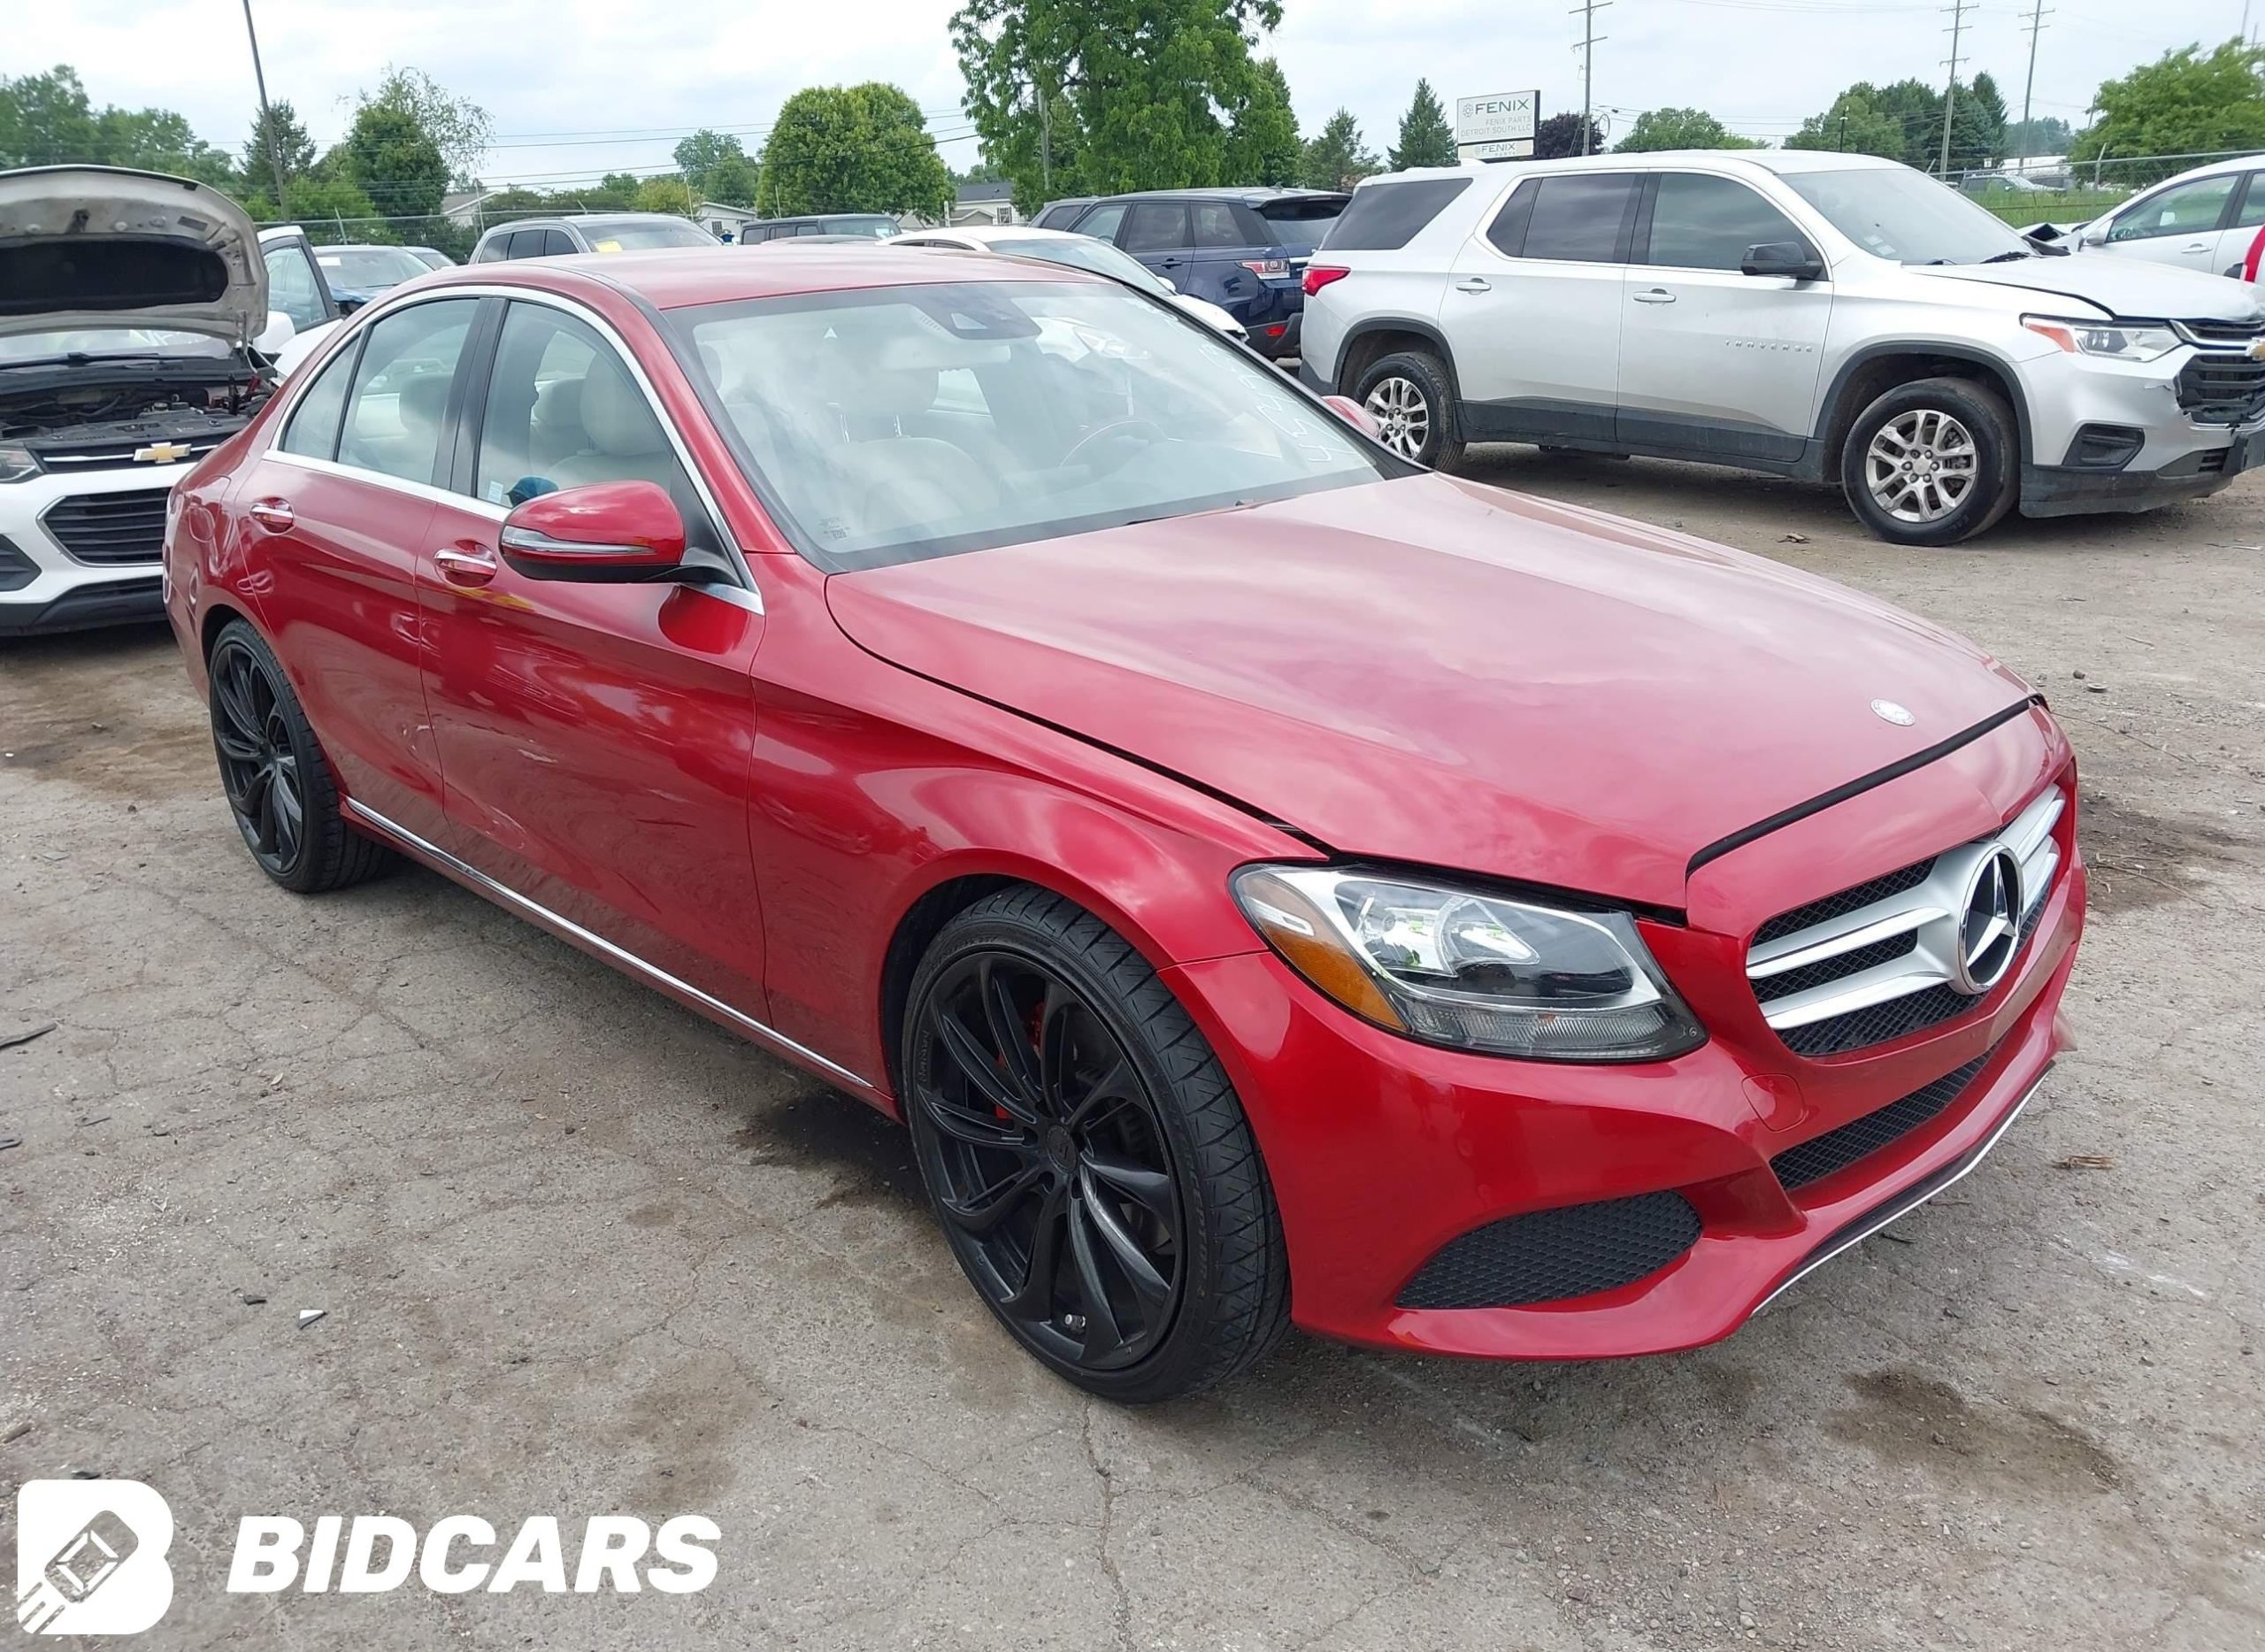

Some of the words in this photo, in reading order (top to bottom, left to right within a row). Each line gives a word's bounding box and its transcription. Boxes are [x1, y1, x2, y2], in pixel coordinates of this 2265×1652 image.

[1475, 98, 1530, 115] FENIX
[1486, 118, 1506, 127] FENIX
[1508, 115, 1532, 125] PARTS
[1461, 127, 1491, 137] DETROIT
[1493, 125, 1516, 134] SOUTH
[1481, 142, 1516, 153] FENIX
